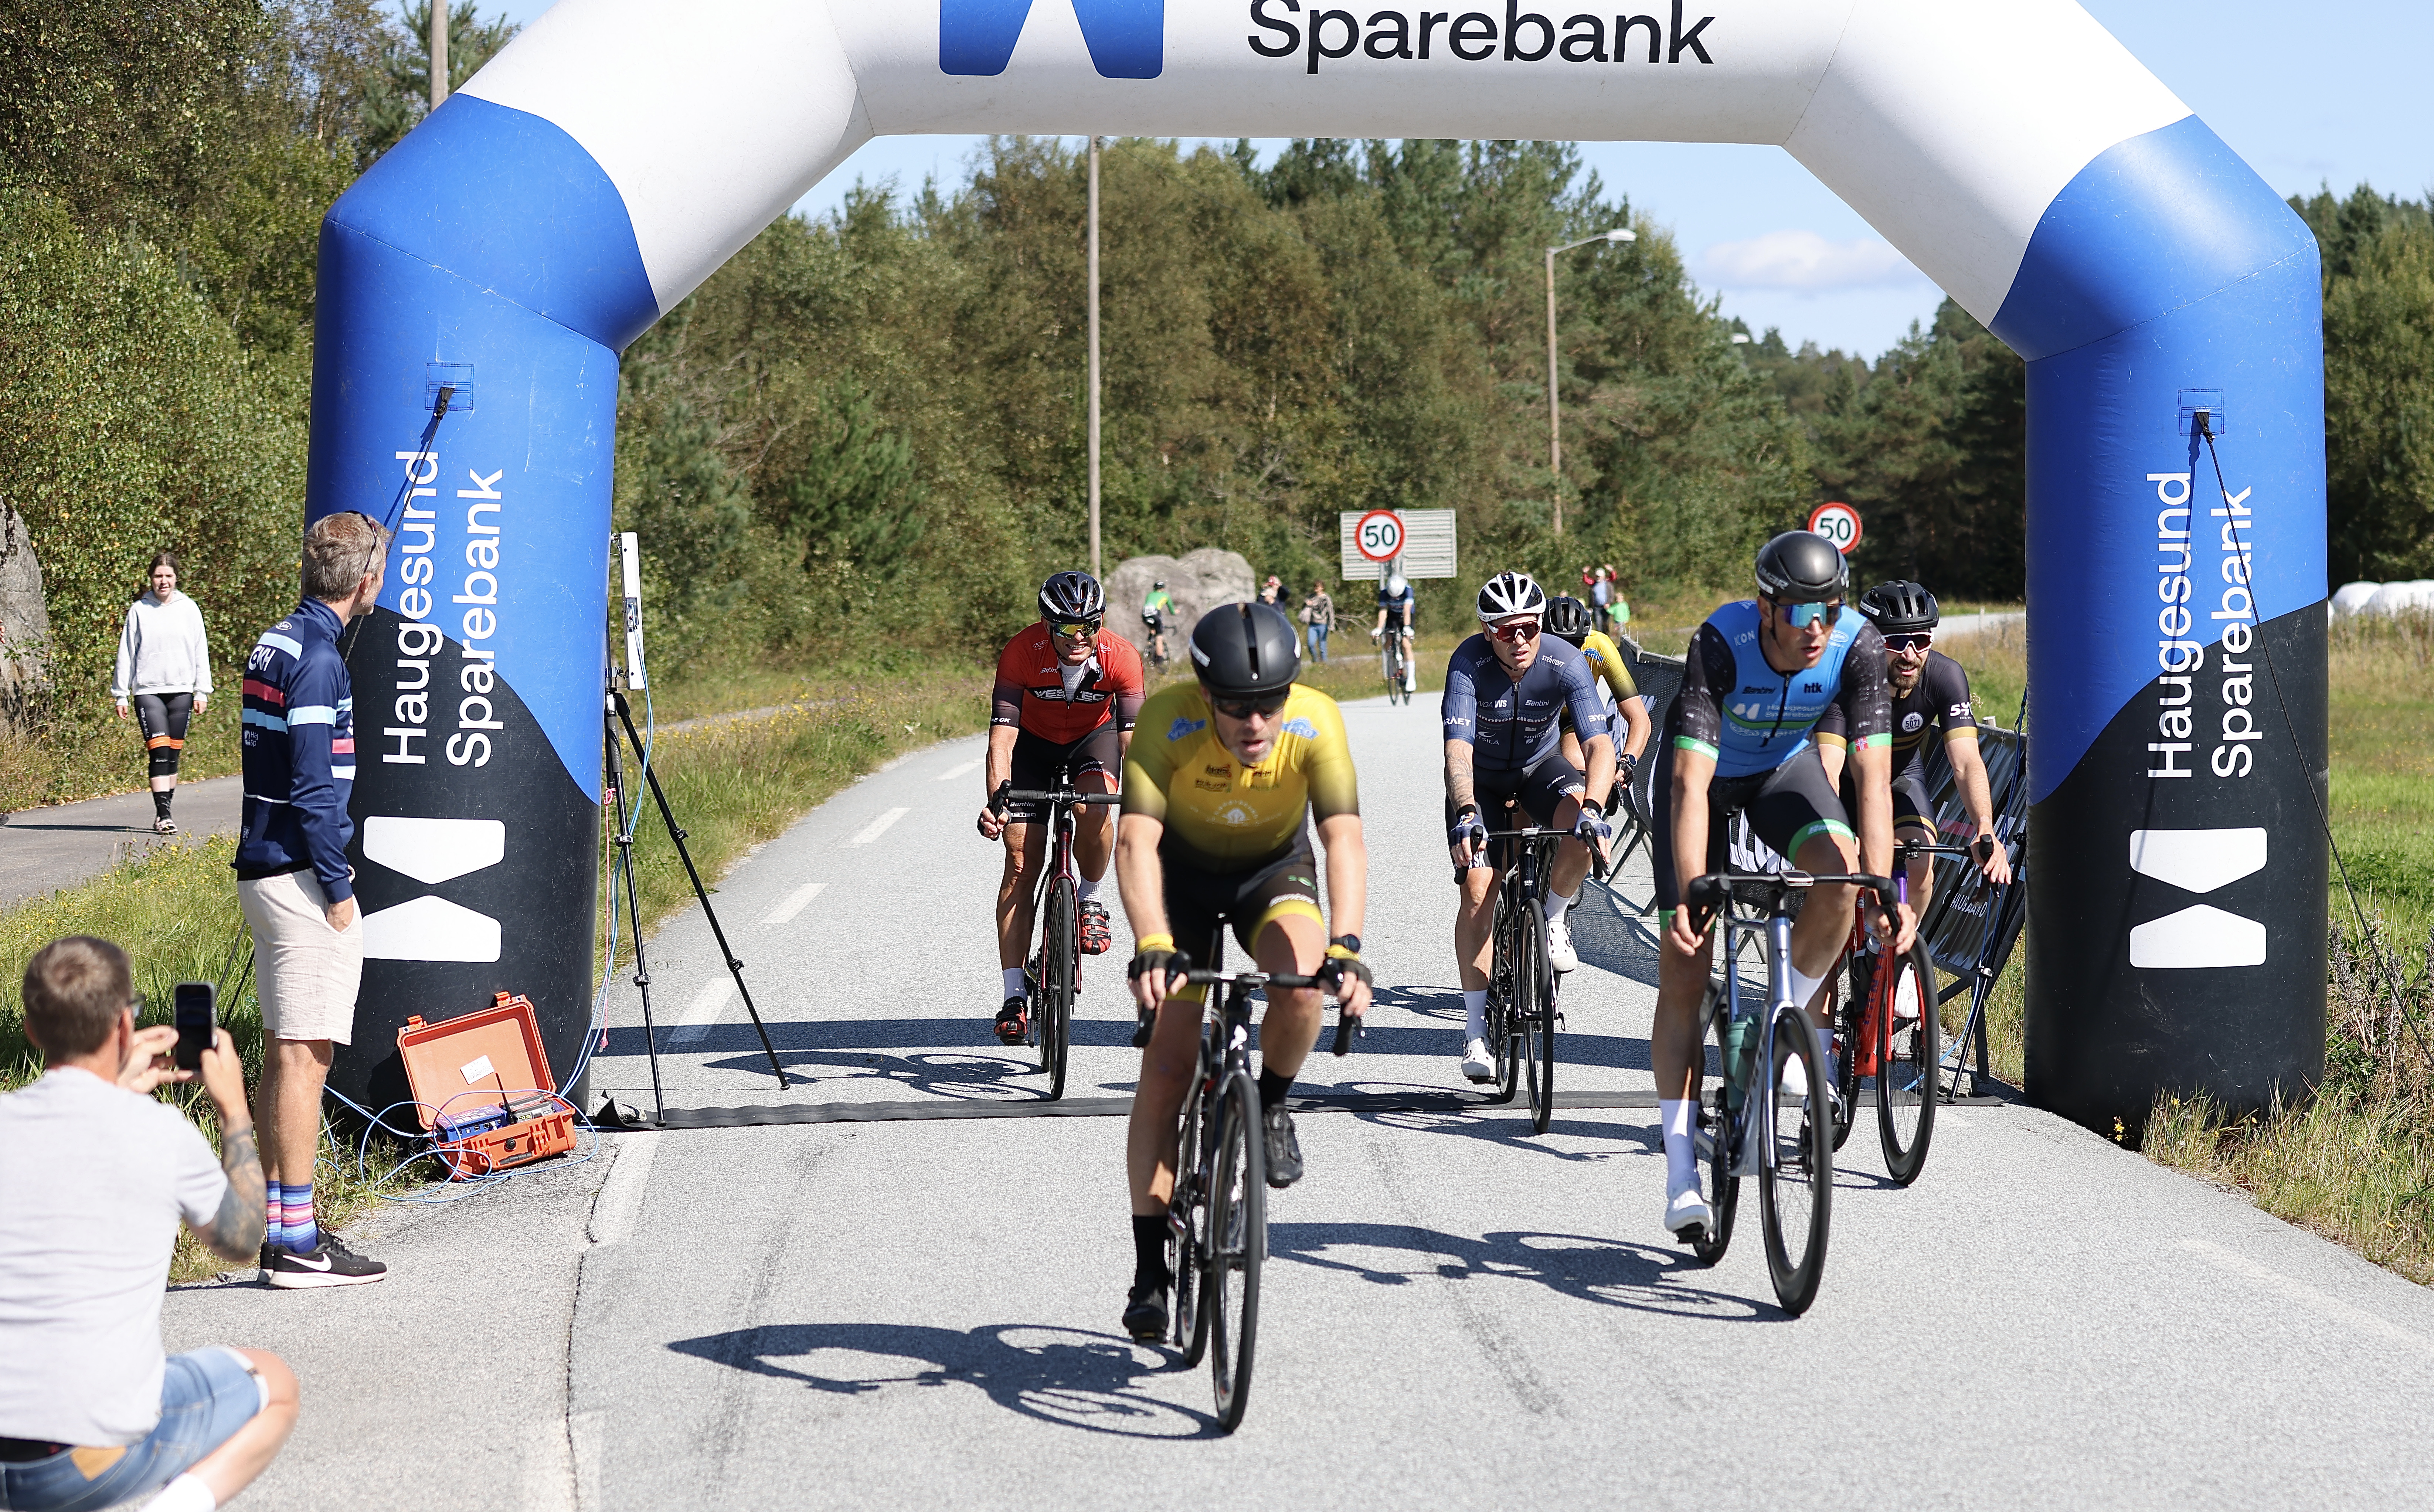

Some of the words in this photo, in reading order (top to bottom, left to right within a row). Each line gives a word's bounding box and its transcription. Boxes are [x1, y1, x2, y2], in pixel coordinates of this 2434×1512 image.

[1248, 0, 1716, 74] Sparebank
[1365, 524, 1395, 547] 50
[1819, 518, 1851, 540] 50
[383, 451, 443, 765] Haugesund
[446, 469, 504, 767] Sparebank
[2146, 472, 2204, 778] Haugesund
[2210, 486, 2263, 778] Sparebank
[1476, 656, 1493, 667] STEINTØFT
[1541, 655, 1565, 667] STEINTØFT
[1804, 683, 1822, 694] htk
[1905, 719, 1920, 728] 5071
[1105, 771, 1115, 779] CK
